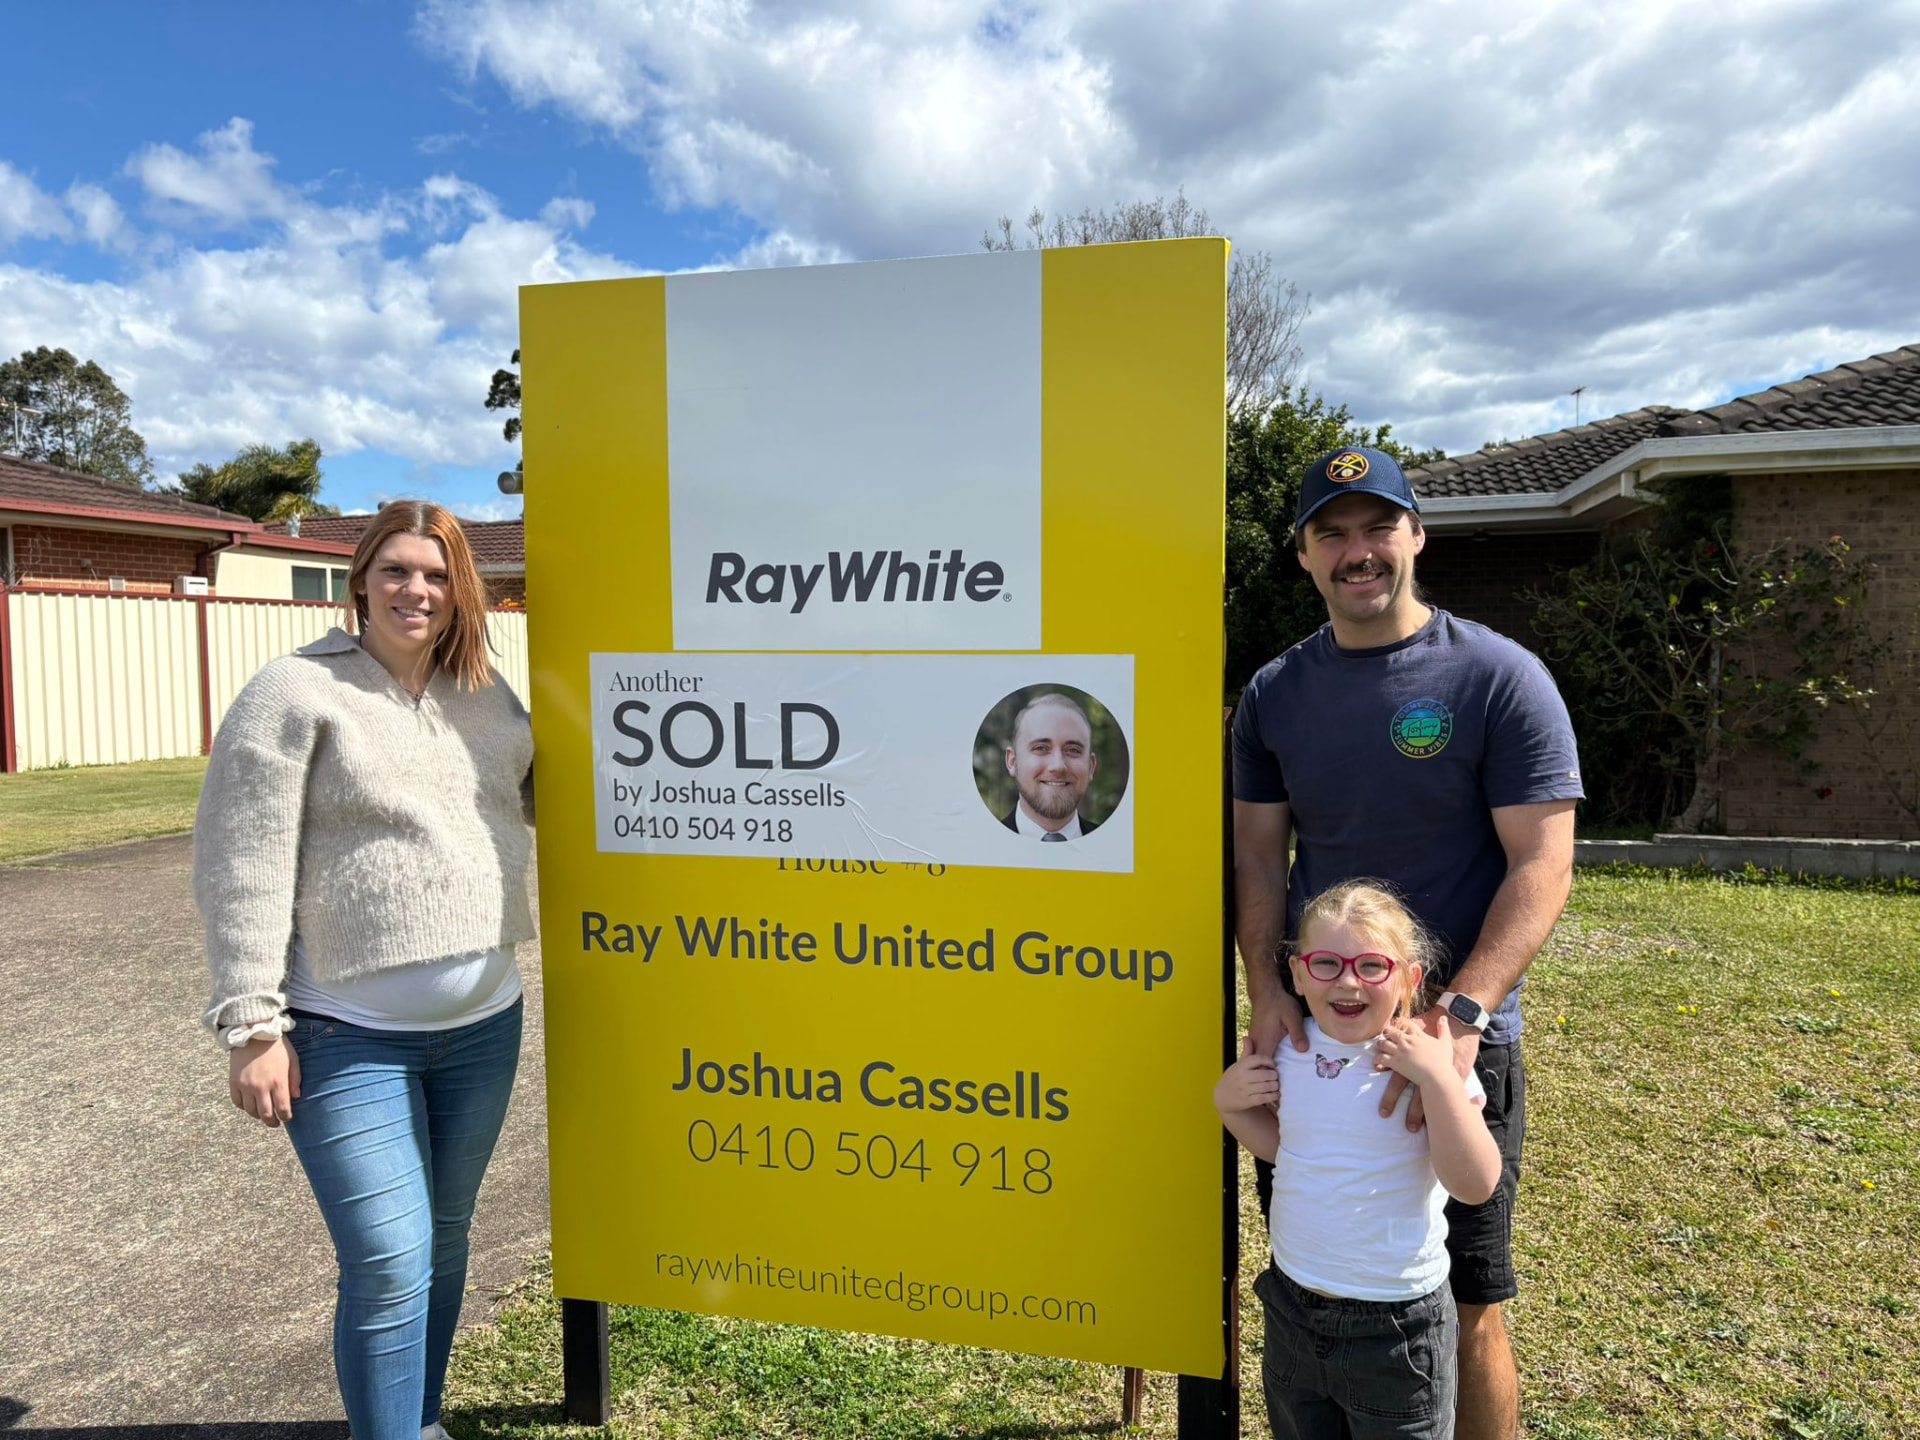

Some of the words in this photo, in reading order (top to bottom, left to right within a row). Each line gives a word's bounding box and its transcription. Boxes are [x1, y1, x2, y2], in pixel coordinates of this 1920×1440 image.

[610, 670, 703, 693] Another
[612, 700, 840, 770] SOLD
[1395, 734, 1425, 755] SUMMER
[1428, 733, 1448, 752] VIBES
[613, 779, 642, 807] by
[650, 780, 736, 805] Joshua
[744, 781, 846, 807] Cassells
[614, 815, 679, 839] 0410
[688, 817, 736, 841] 504
[744, 818, 793, 843] 918
[581, 911, 662, 963] Ray
[674, 915, 817, 963] White
[833, 922, 995, 972] United
[1012, 931, 1174, 992] Group
[672, 1047, 842, 1103] Joshua
[859, 1061, 1070, 1122] Cassells
[688, 1119, 814, 1172] 0410
[835, 1131, 932, 1183] 504
[952, 1142, 1053, 1195] 918
[655, 1251, 1098, 1326] raywhiteunitedgroup.com
